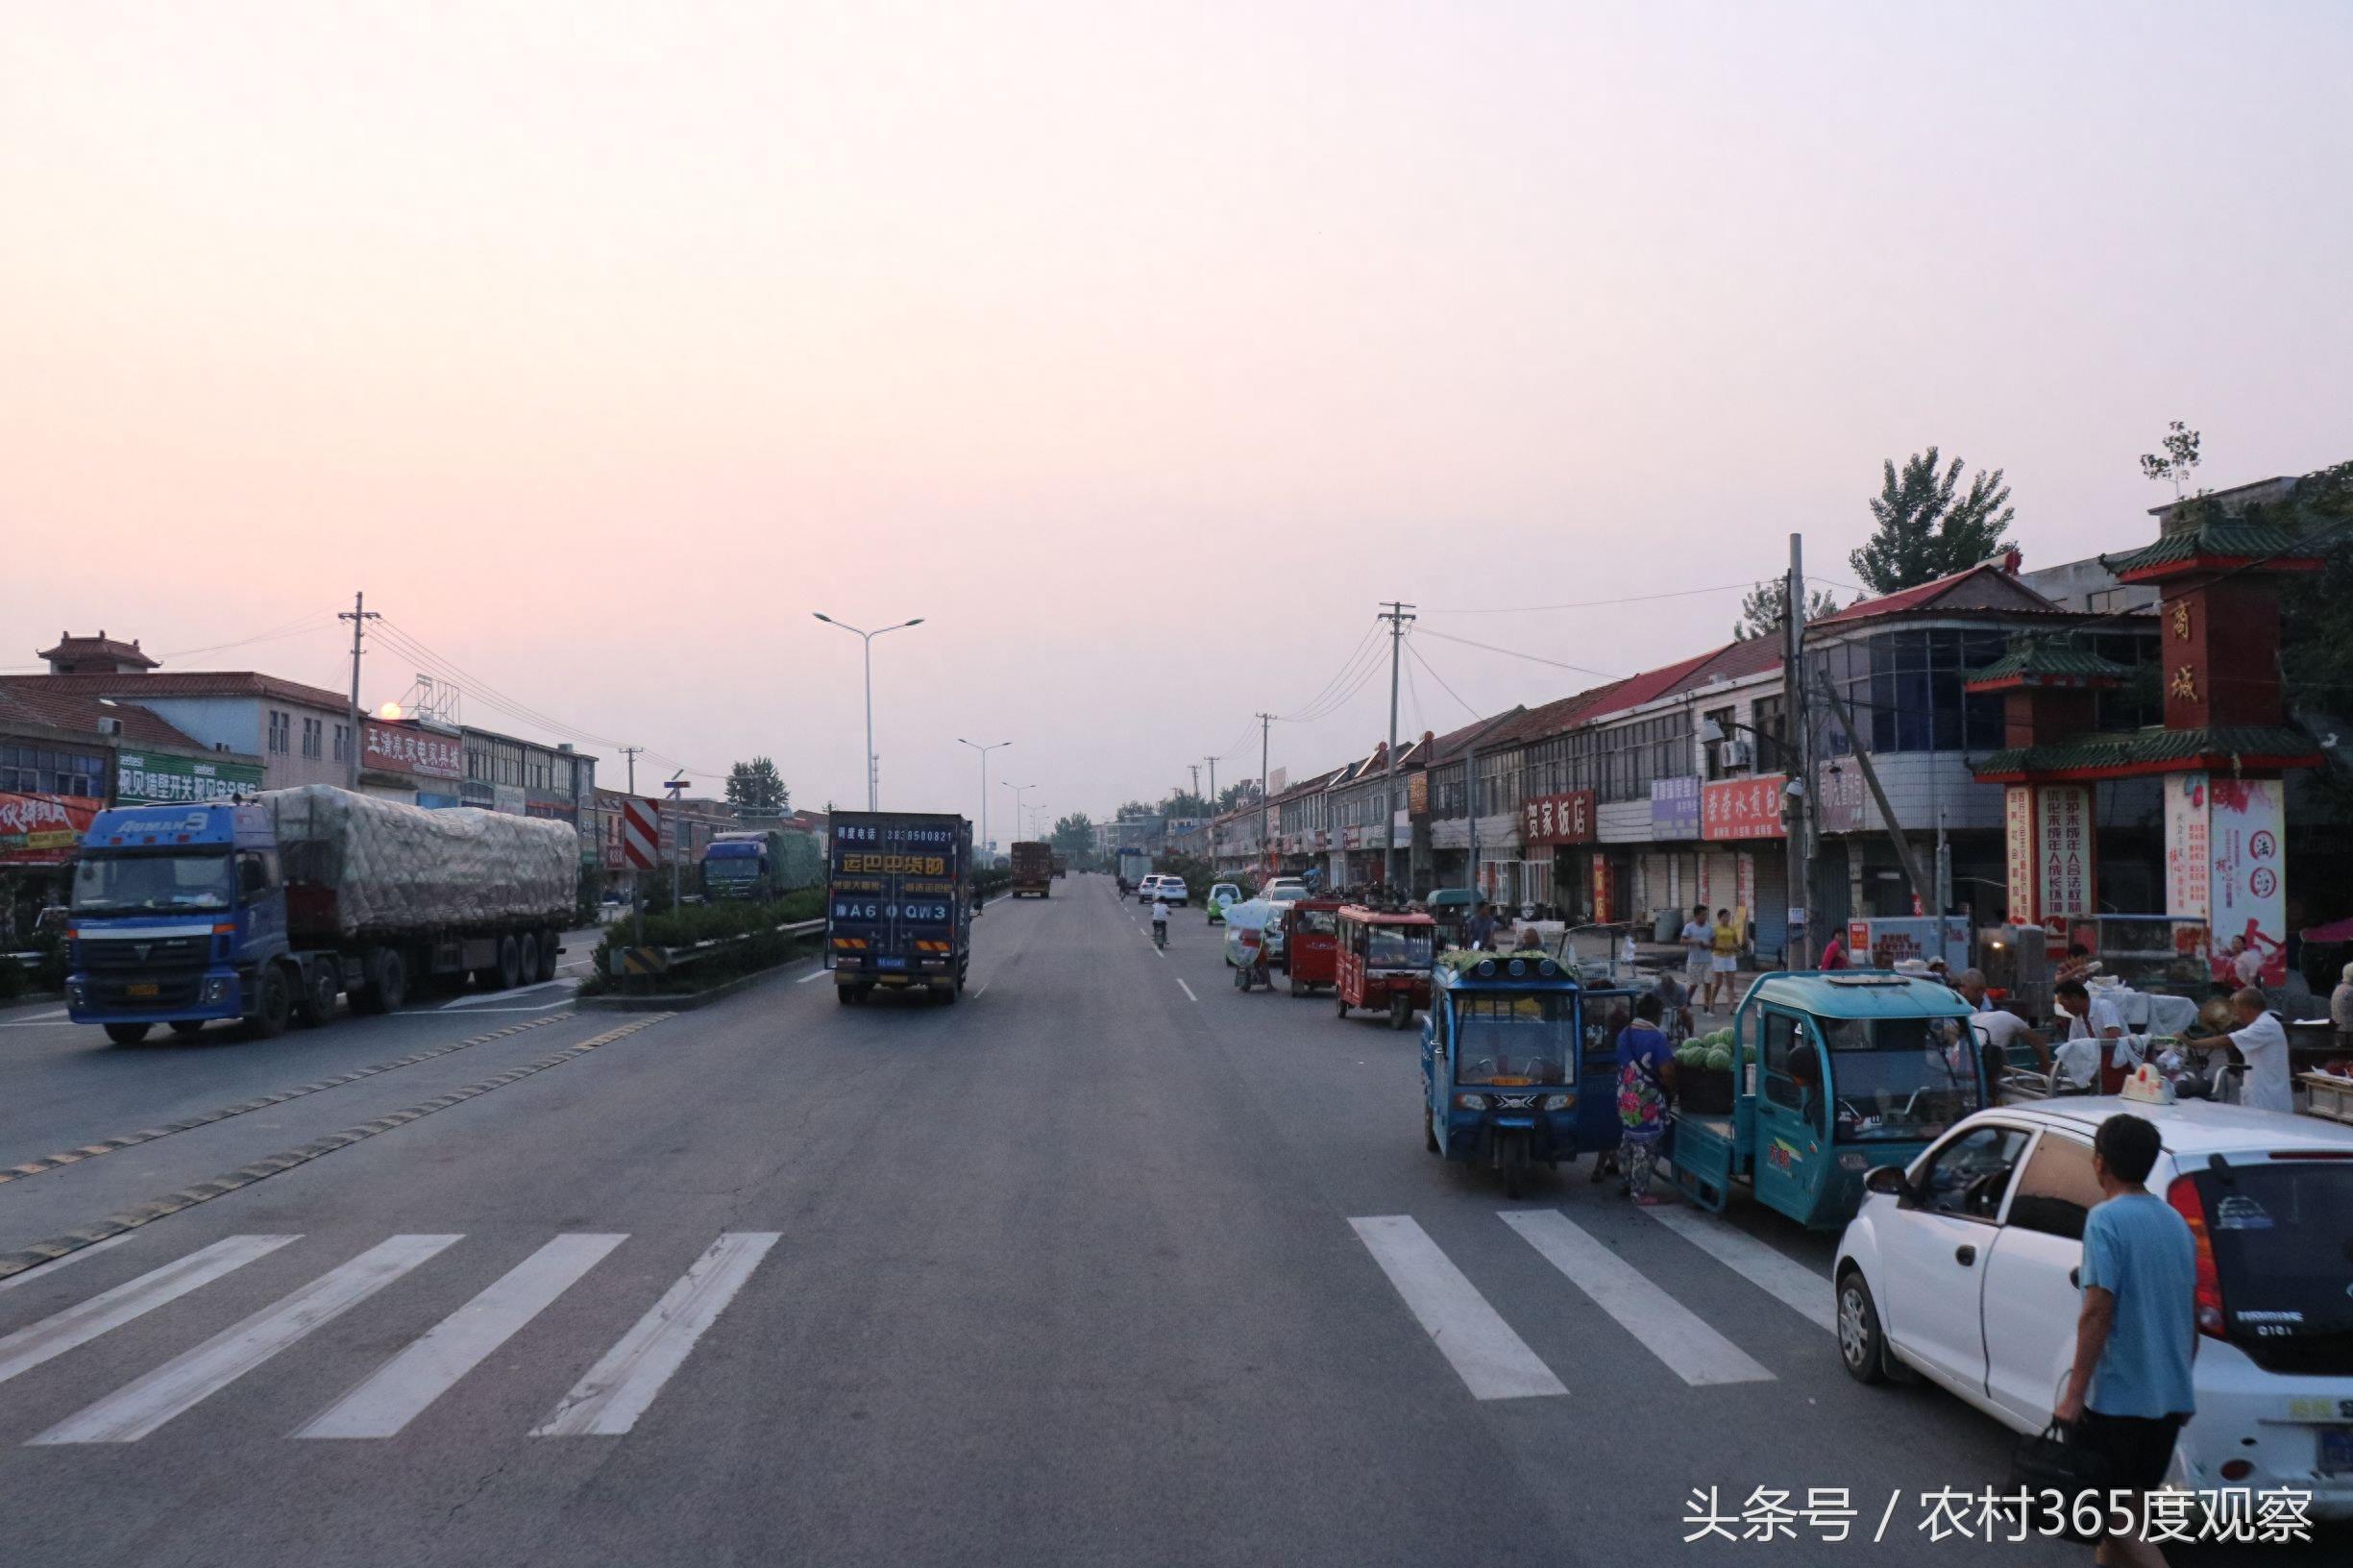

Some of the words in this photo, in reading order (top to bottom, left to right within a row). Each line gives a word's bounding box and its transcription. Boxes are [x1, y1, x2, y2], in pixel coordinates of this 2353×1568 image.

[2171, 600, 2198, 702] 商城
[1527, 796, 1586, 839] 贺家饭店
